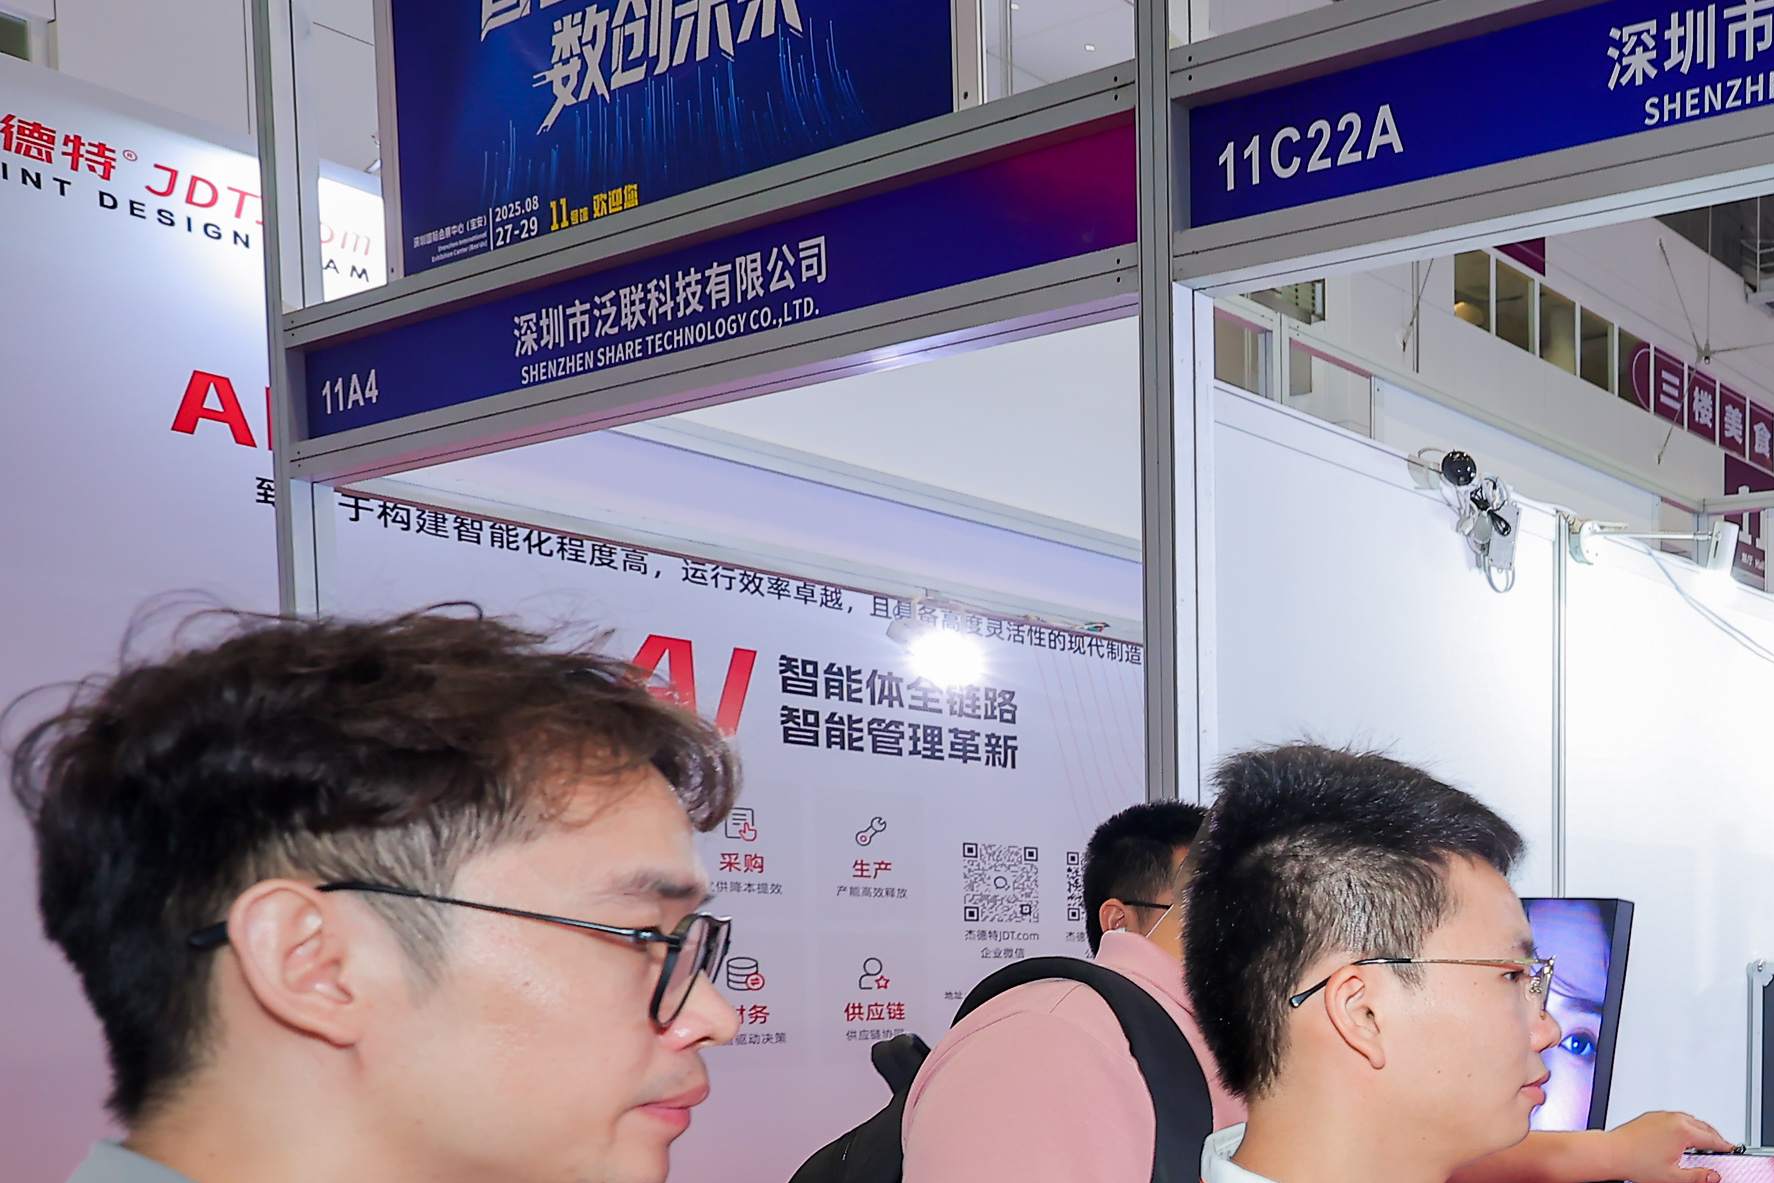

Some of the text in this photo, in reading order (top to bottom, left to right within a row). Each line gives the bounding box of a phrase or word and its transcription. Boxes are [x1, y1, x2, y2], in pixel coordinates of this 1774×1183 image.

[1217, 103, 1404, 191] 11C22A
[98, 189, 251, 250] DESIGN
[494, 195, 540, 223] 2025.08
[592, 183, 640, 220] 欢迎您
[494, 216, 539, 248] 27-29
[512, 235, 828, 358] 深圳市泛联科技有限公司
[520, 297, 820, 386] SHENZHEN SHARE TECHNOLOGY CO.,LTD.
[170, 369, 273, 451] A
[321, 368, 379, 415] 11A4
[777, 653, 1019, 726] 智能体全链路
[779, 704, 1019, 770] 智能管理革新
[719, 851, 765, 875] 采购
[851, 859, 892, 880] 生产
[709, 880, 784, 896] 供降本提效
[843, 1001, 907, 1023] 供应链
[727, 1031, 787, 1047] 驱动决策
